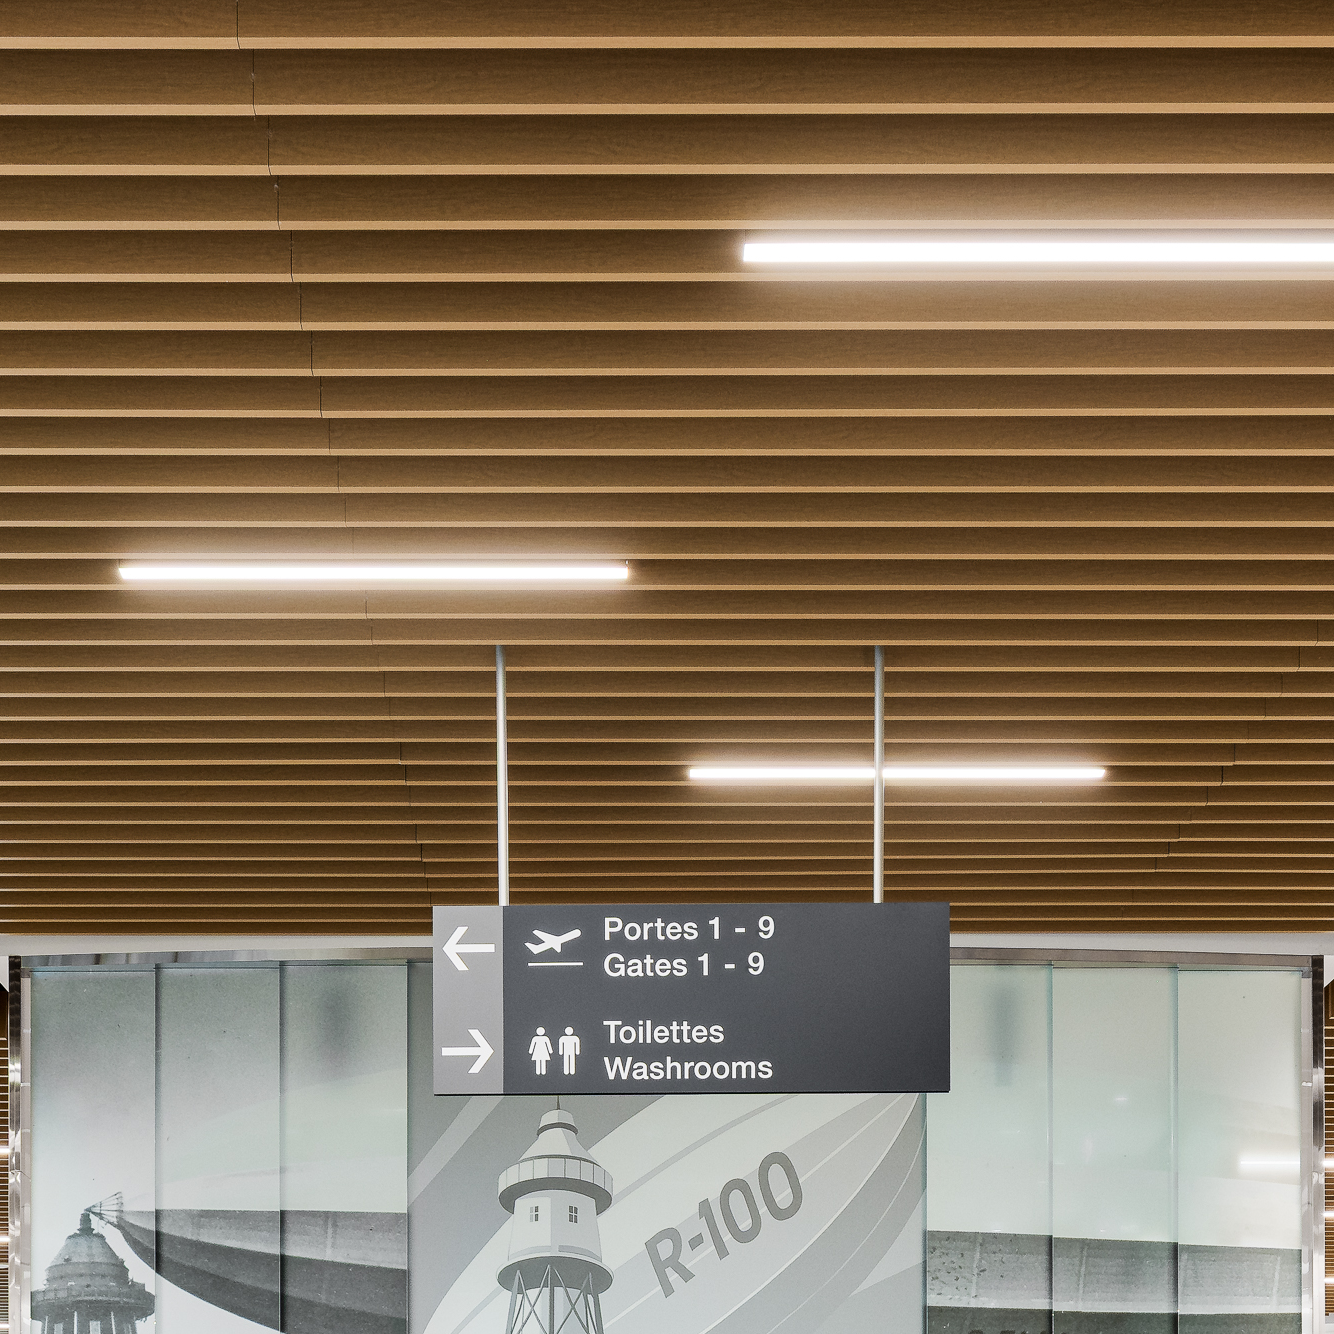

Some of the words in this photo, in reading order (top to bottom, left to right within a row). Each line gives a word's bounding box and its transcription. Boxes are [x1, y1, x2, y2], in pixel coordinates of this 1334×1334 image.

[604, 916, 699, 941] Portes
[708, 916, 720, 940] 1
[758, 915, 775, 940] 9
[603, 952, 688, 978] Gates
[697, 952, 709, 976] 1
[747, 951, 765, 976] 9
[603, 1019, 725, 1044] Toilettes
[603, 1055, 773, 1081] Washrooms
[645, 1152, 803, 1299] R-100
